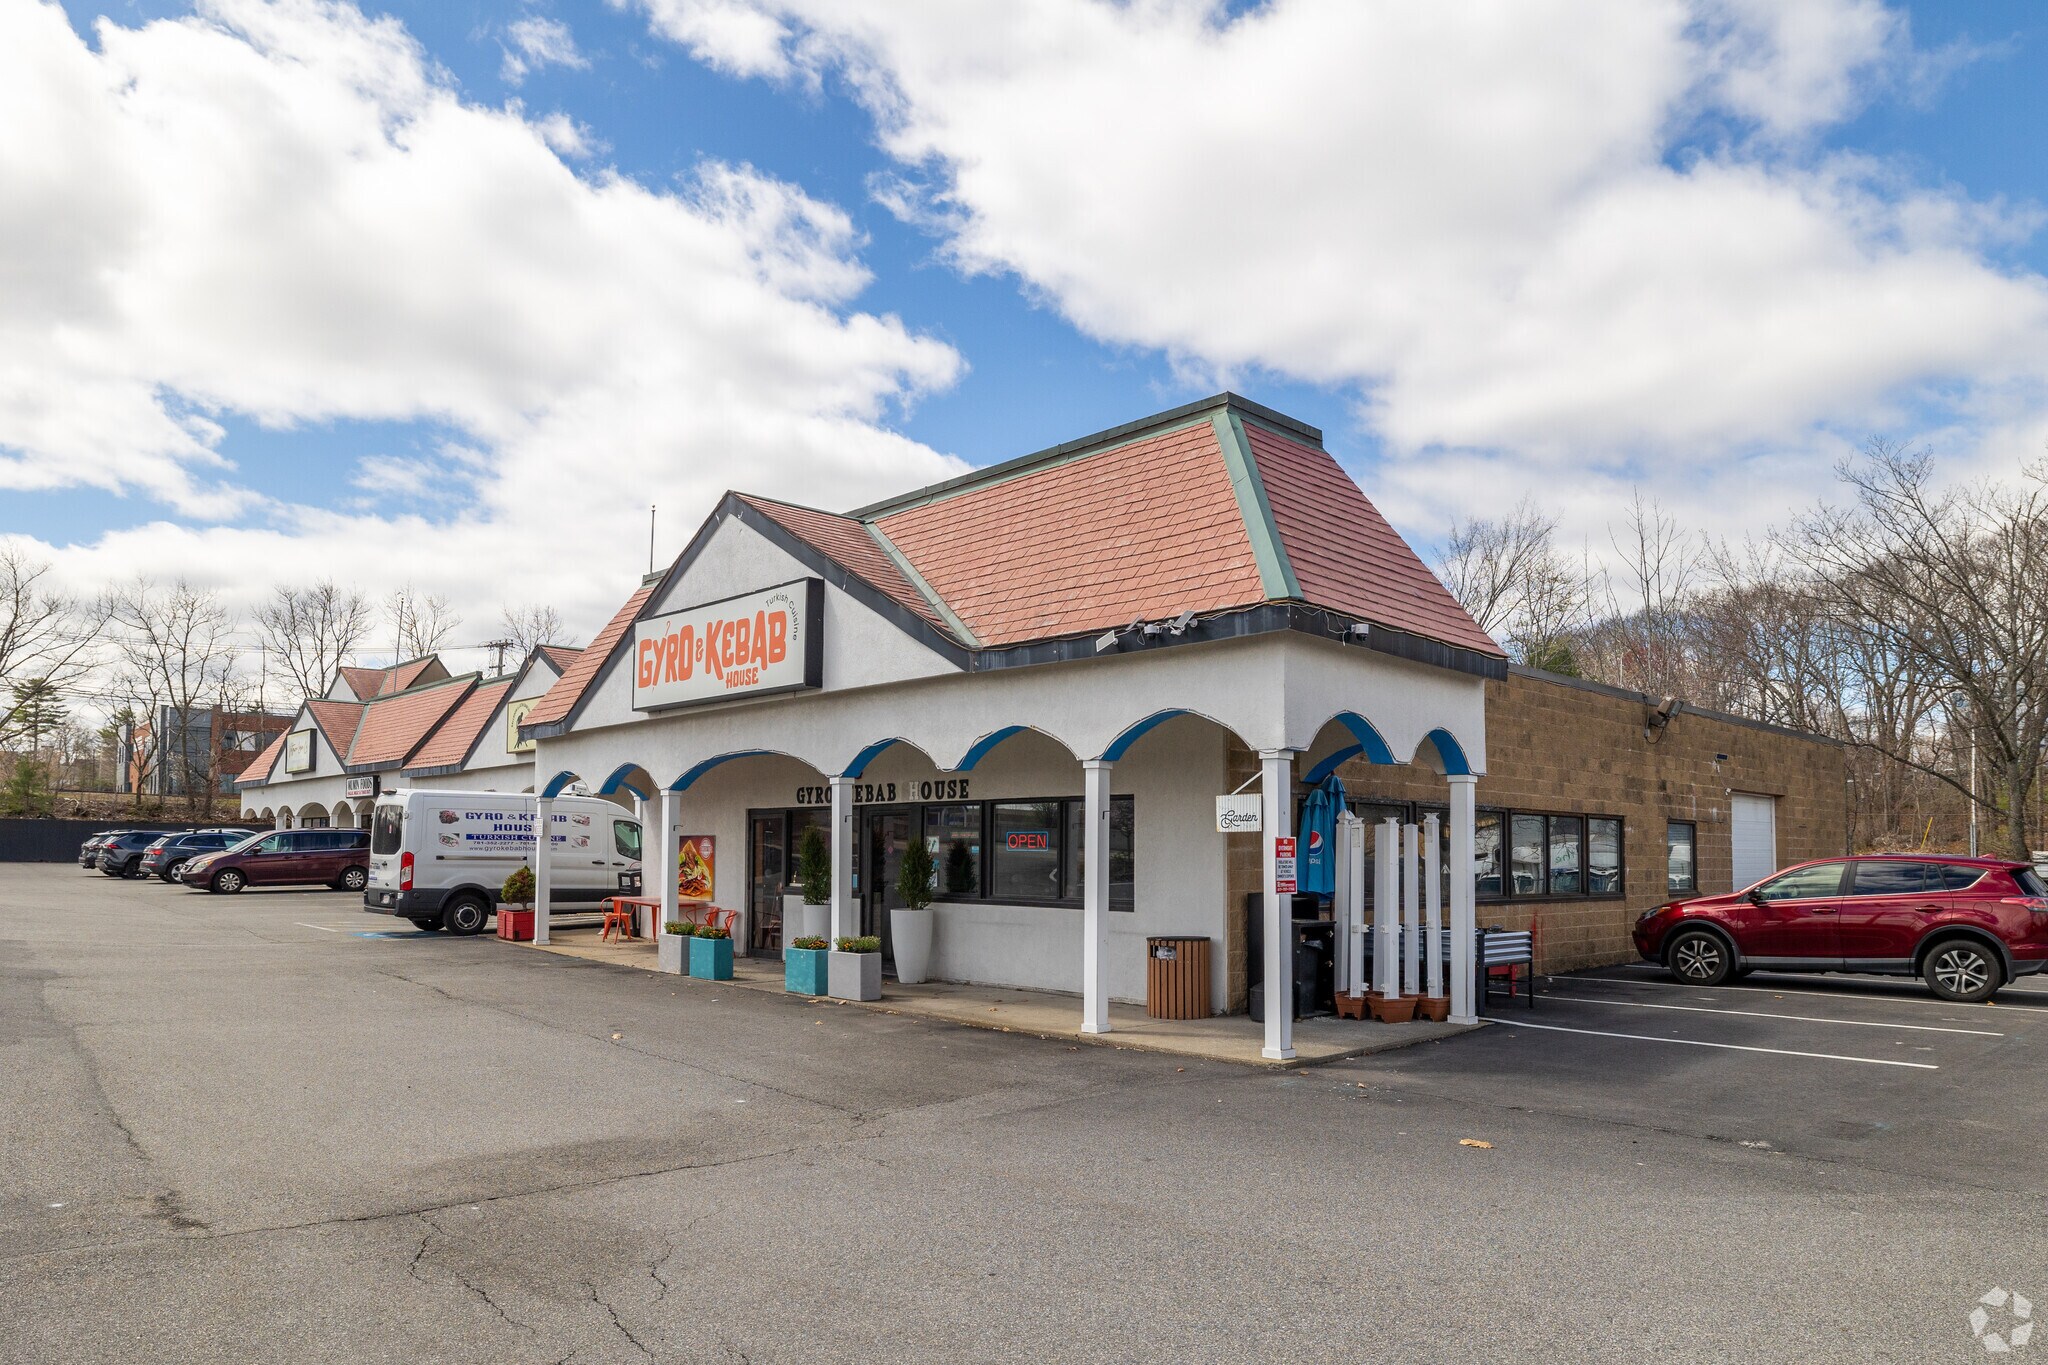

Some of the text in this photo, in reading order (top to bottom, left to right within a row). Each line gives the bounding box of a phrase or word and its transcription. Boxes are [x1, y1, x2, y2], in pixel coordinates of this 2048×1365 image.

[765, 592, 799, 641] Turkish Cuisine
[638, 610, 787, 689] GYRO & KEBAB
[725, 667, 759, 689] HOUSE
[851, 783, 897, 803] EBAB
[908, 779, 970, 801] HOUSE
[465, 812, 503, 821] GYRO
[507, 813, 516, 821] &
[1220, 809, 1259, 829] Garden
[493, 823, 533, 832] HOUS
[1008, 833, 1047, 849] OPEN
